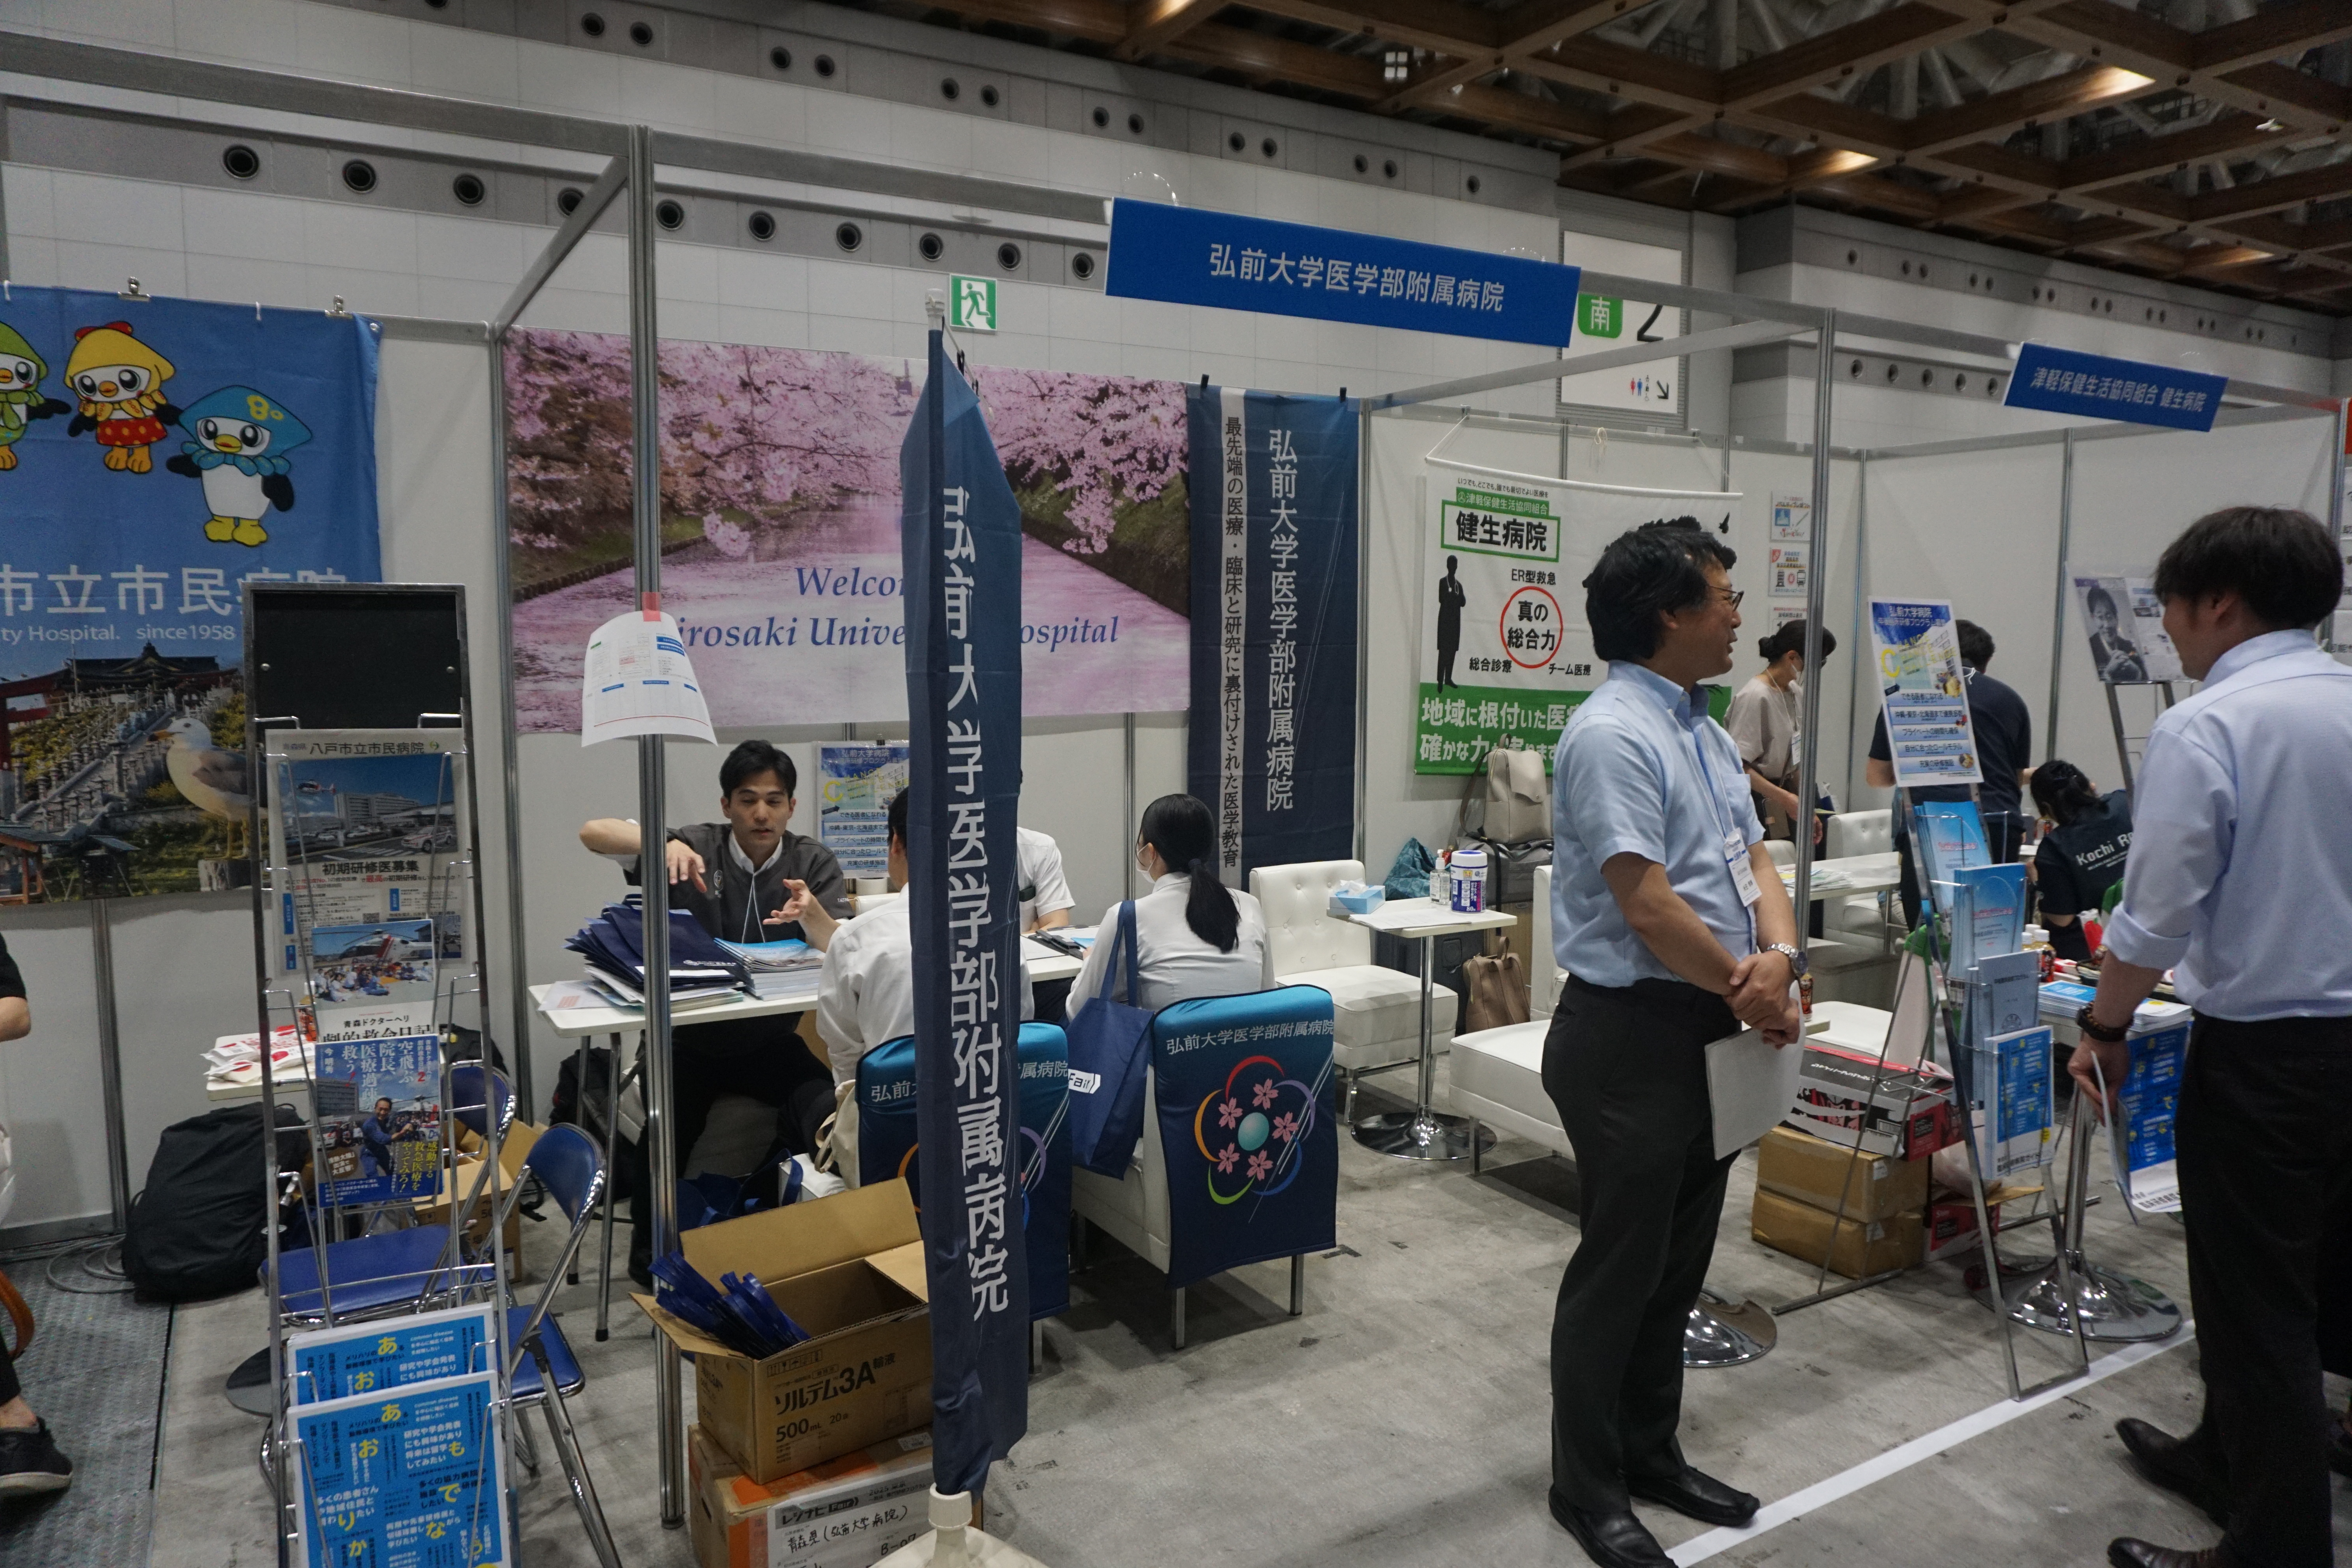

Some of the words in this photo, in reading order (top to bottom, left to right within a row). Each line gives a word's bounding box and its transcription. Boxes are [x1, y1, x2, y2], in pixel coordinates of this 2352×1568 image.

[1210, 243, 1505, 312] 弘前大学医学部附属病院
[1591, 296, 1610, 332] 南
[2030, 367, 2159, 405] 津軽保健生活協同組合
[2160, 387, 2207, 412] 健生病院
[1466, 492, 1548, 515] 津軽保健生活協同組合
[1455, 510, 1548, 552] 健生病院
[796, 567, 906, 596] Welco
[1511, 568, 1556, 586] ER型救急
[1266, 429, 1298, 812] 弘前大学医学部附属病院
[1517, 600, 1548, 622] 真の
[29, 624, 120, 644] Hospital.
[136, 624, 235, 641] since1958
[678, 617, 796, 647] irosaki
[810, 617, 905, 646] Unive
[1020, 616, 1119, 653] ospital
[1222, 416, 1244, 868] 最先端の医療・臨床と研究に裏付けされた医学教育
[1507, 628, 1555, 651] 総合力
[1469, 657, 1512, 673] 総合診療
[1549, 663, 1591, 676] チーム医療
[310, 742, 424, 755] 八戸市立市民病院
[841, 749, 889, 758] 弘前大学病院
[2076, 840, 2115, 866] Kochi
[322, 860, 419, 875] 初期研修医募集
[343, 1015, 409, 1028] 青森ドクターヘリ
[1166, 1019, 1334, 1055] 弘前大学医学部附属病院
[397, 1040, 415, 1084] 空飛ぶ
[417, 1071, 426, 1082] 2
[871, 1080, 916, 1102] 弘前
[1018, 1060, 1068, 1080] 属病院
[412, 1141, 425, 1191] 救急医療を
[426, 1141, 438, 1178] 感動する
[399, 1354, 456, 1372] 研究や学会発表
[775, 1361, 877, 1417] ソルテム3A
[872, 1352, 896, 1370] 輸液
[775, 1418, 822, 1443] 500mL
[406, 1454, 446, 1470] してみたい
[831, 1501, 851, 1511] Fair
